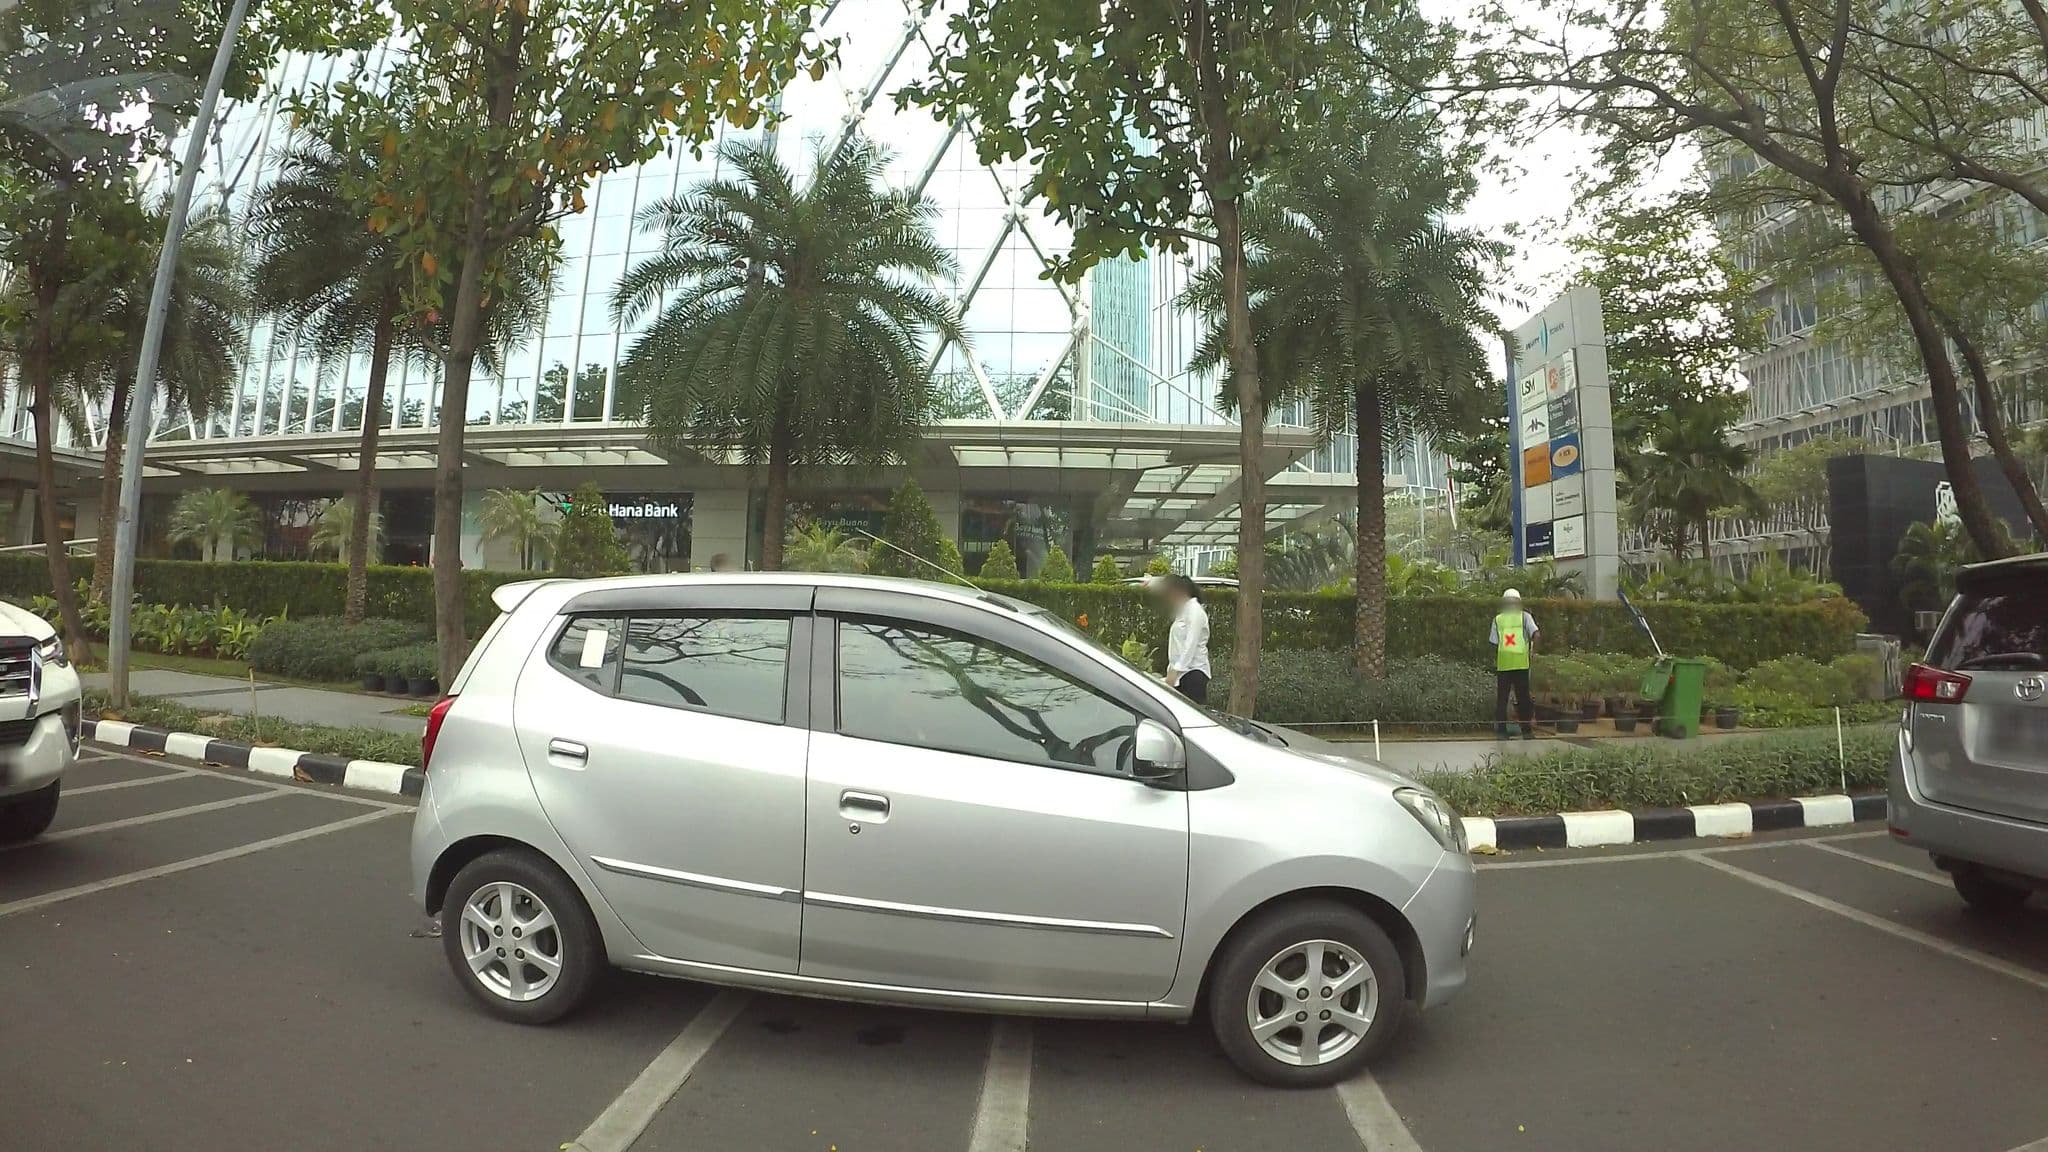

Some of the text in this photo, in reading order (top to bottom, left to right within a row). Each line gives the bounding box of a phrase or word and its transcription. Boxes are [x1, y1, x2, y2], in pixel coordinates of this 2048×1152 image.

[1521, 378, 1536, 396] LSM
[609, 503, 643, 518] Hana
[644, 503, 679, 518] Bank
[816, 517, 838, 528] Byu
